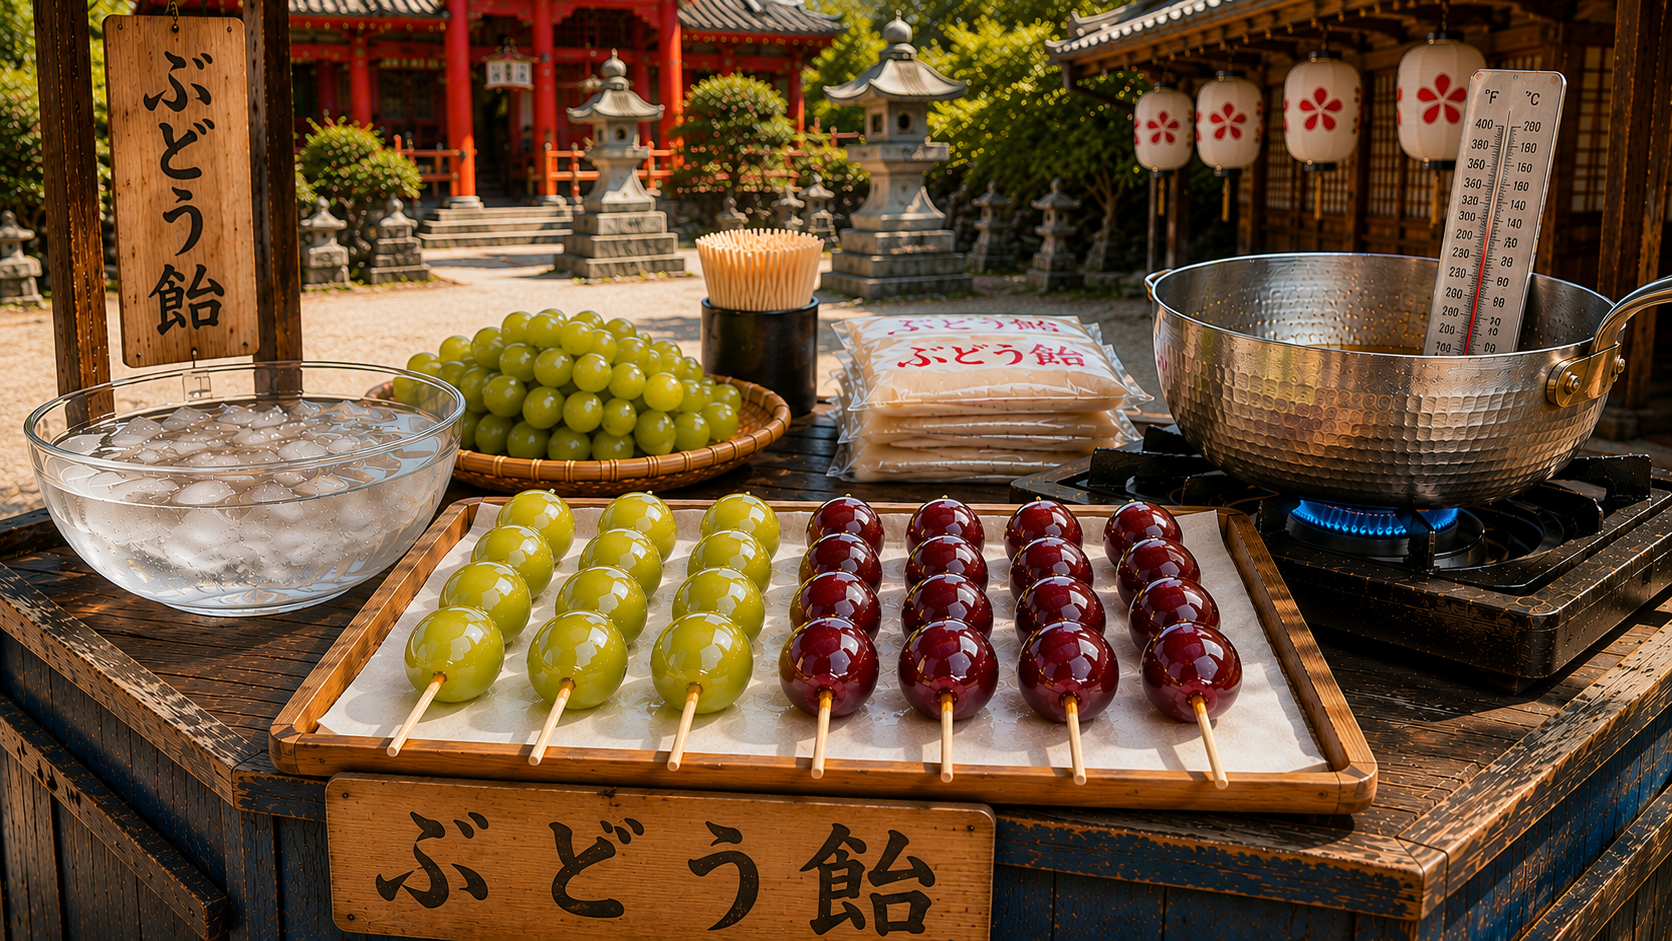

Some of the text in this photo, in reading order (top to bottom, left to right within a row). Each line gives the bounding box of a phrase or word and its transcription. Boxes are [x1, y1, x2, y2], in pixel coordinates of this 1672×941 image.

[1485, 89, 1499, 104] °F
[1475, 118, 1493, 130] 400
[1471, 138, 1489, 150] 380
[1520, 142, 1537, 154] 180
[1468, 157, 1485, 170] 360
[143, 51, 225, 337] ぶどう飴
[1510, 199, 1526, 211] 140
[1458, 210, 1476, 222] 300
[1456, 228, 1473, 240] 200
[1439, 322, 1455, 335] 200
[897, 343, 1085, 368] ぶどう飴
[375, 810, 937, 937] ぶどう飴
